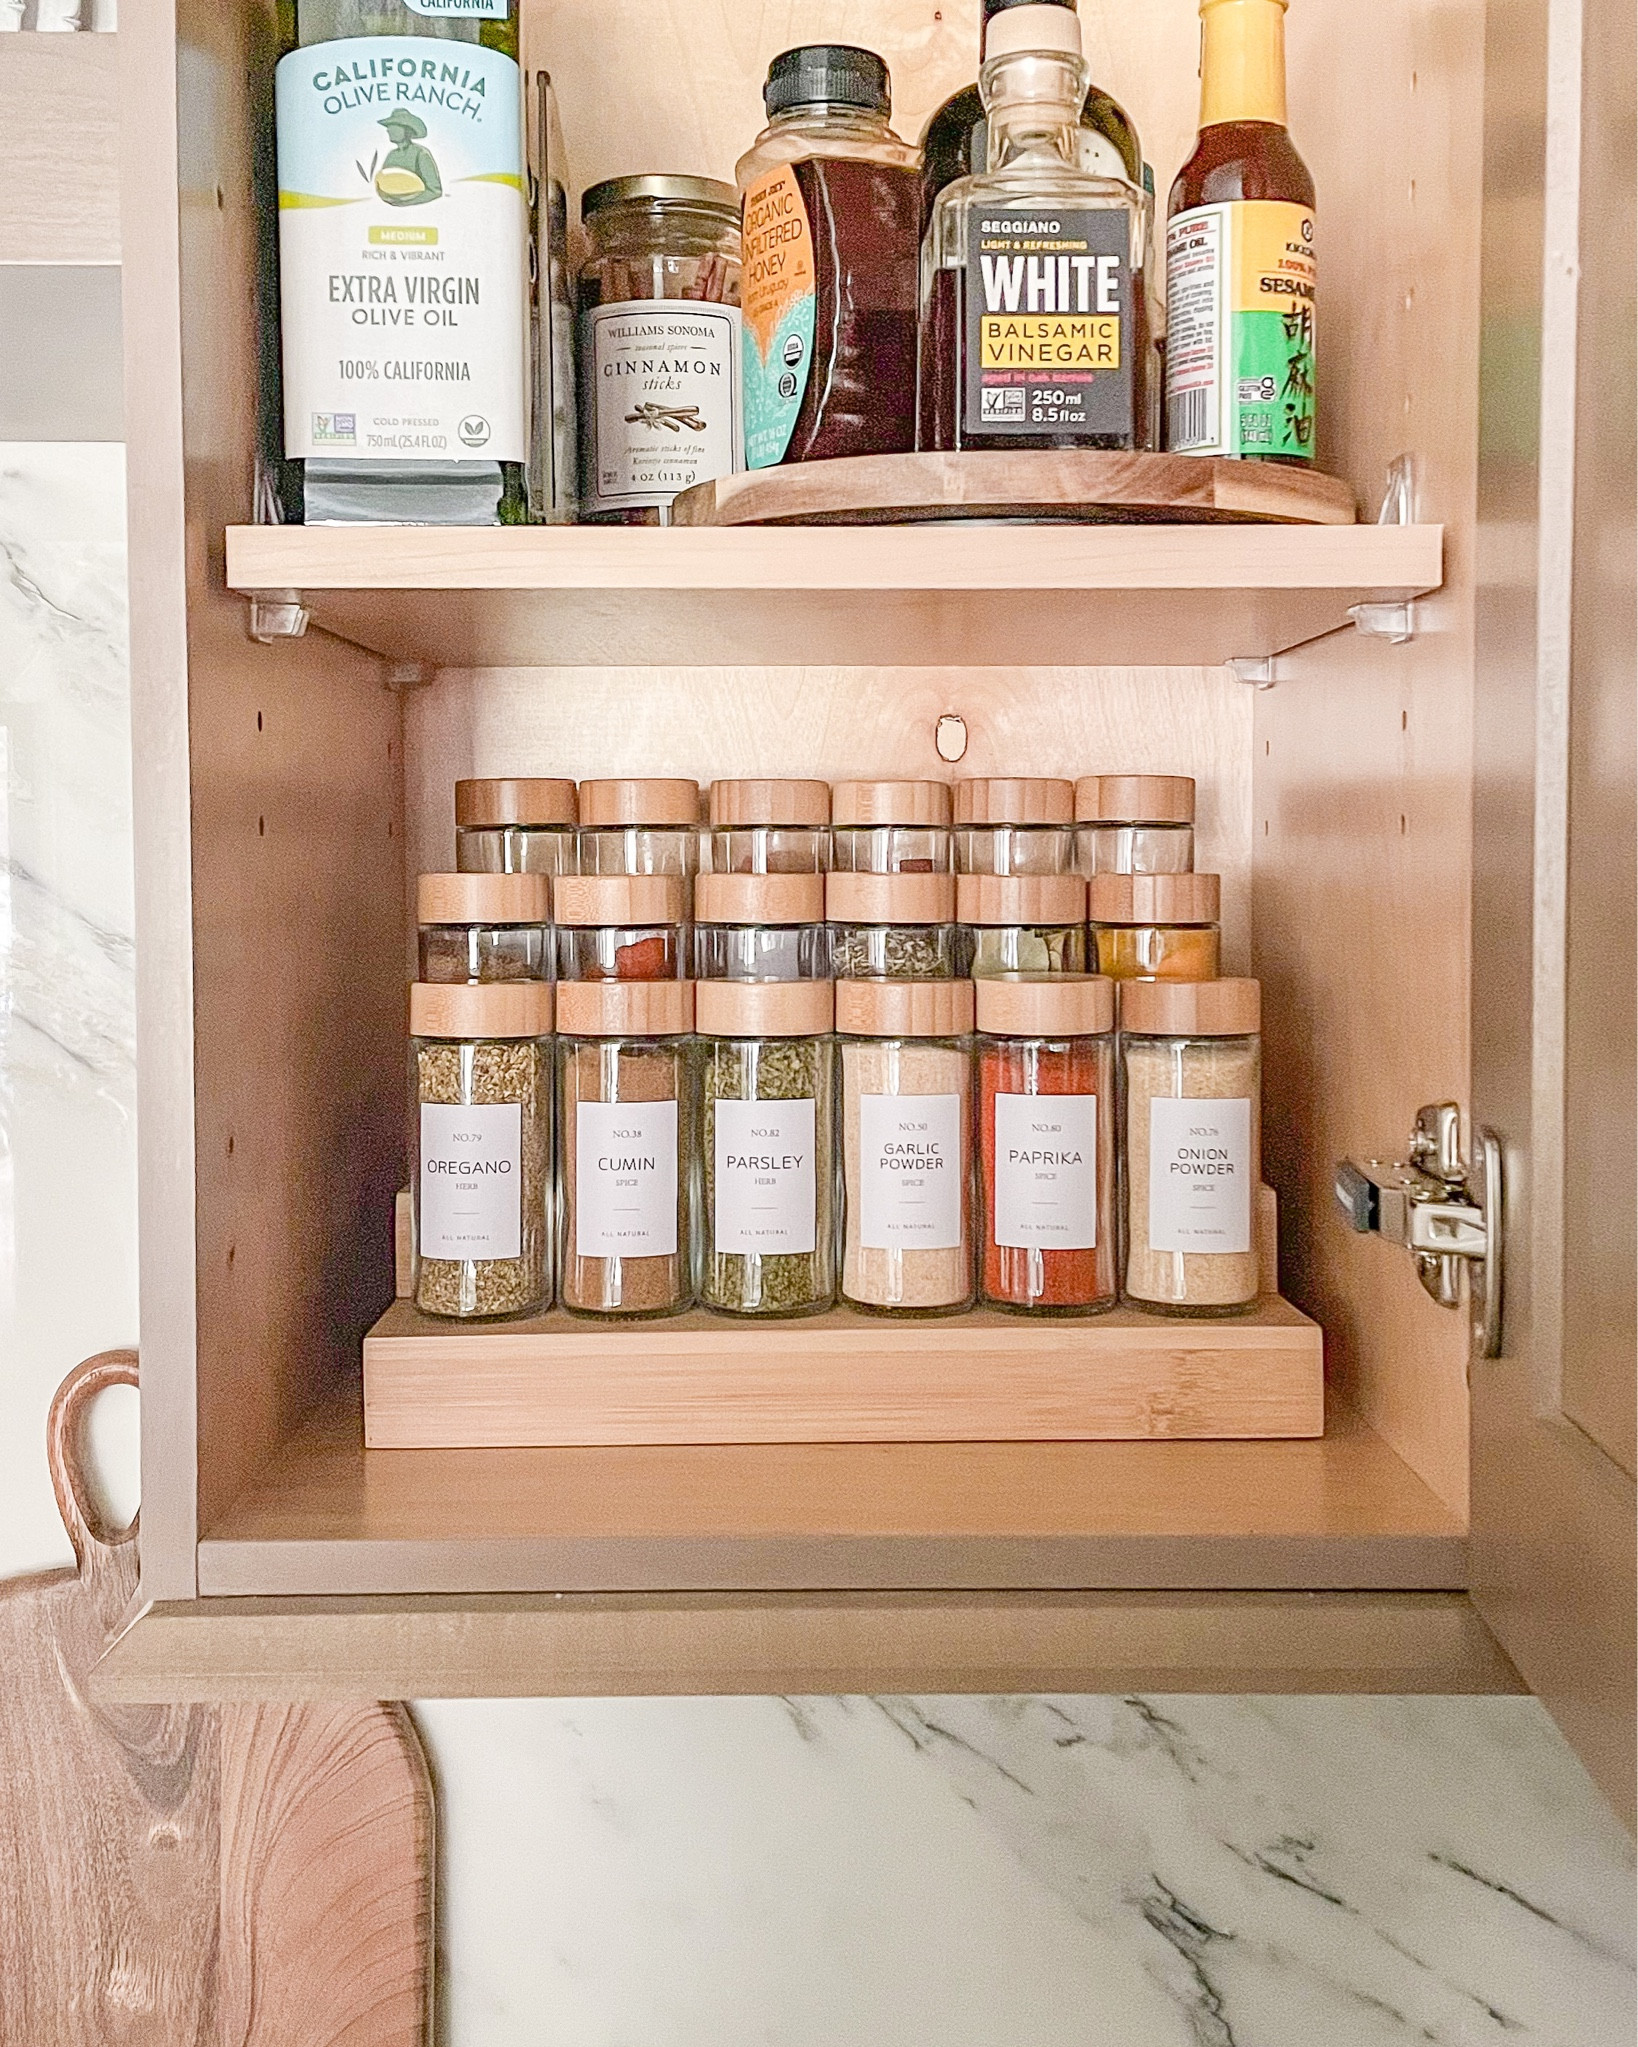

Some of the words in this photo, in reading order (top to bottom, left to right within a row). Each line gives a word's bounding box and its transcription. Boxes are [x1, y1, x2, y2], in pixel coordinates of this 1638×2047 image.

[420, 0, 494, 10] CALIFORNIA
[312, 58, 487, 98] CALIFORNIA
[323, 82, 391, 115] OLIVE
[745, 192, 794, 236] ORGANIC
[981, 220, 1061, 234] SEGGIANO
[380, 230, 427, 242] MEDIUM
[981, 240, 1012, 250] LIGHT
[1022, 240, 1089, 251] REFRESHING
[361, 250, 388, 261] RICH
[390, 251, 398, 261] &
[400, 251, 446, 262] VIBRANT
[748, 250, 786, 289] HONEY
[328, 275, 398, 304] EXTRA
[404, 276, 481, 306] VIRGIN
[980, 255, 1120, 313] WHITE
[351, 308, 416, 327] OLIVE
[423, 309, 459, 327] OIL
[607, 325, 665, 339] WILLIAMS
[667, 325, 716, 339] SONOMA
[988, 322, 1113, 339] BALSAMIC
[988, 343, 1114, 362] VINEGAR
[338, 360, 380, 380] 100%
[383, 361, 472, 382] CALIFORNIA
[603, 359, 721, 377] CINNAMON
[642, 376, 682, 390] sticks
[373, 417, 399, 427] COLD
[402, 418, 440, 428] PRESSED
[640, 473, 655, 482] OZ
[658, 470, 682, 483] (113
[685, 470, 696, 485] g)
[452, 1132, 483, 1143] NO.79
[612, 1129, 643, 1139] NO.38
[750, 1128, 780, 1138] NO.82
[883, 1142, 940, 1156] GARLIC
[1177, 1148, 1229, 1161] ONION
[598, 1157, 656, 1172] CUMIN
[726, 1155, 804, 1170] PARSLEY
[879, 1157, 944, 1171] POWDER
[1009, 1149, 1083, 1166] PAPRIKA
[427, 1159, 512, 1175] OREGANO
[1169, 1162, 1235, 1176] POWDER
[615, 1178, 640, 1187] SPICE
[754, 1177, 777, 1186] HERB
[901, 1178, 926, 1187] SPICE
[1035, 1172, 1057, 1181] SPICE
[455, 1182, 479, 1191] HERB
[1192, 1184, 1215, 1193] SPICE
[1035, 1224, 1069, 1232] NATURAL
